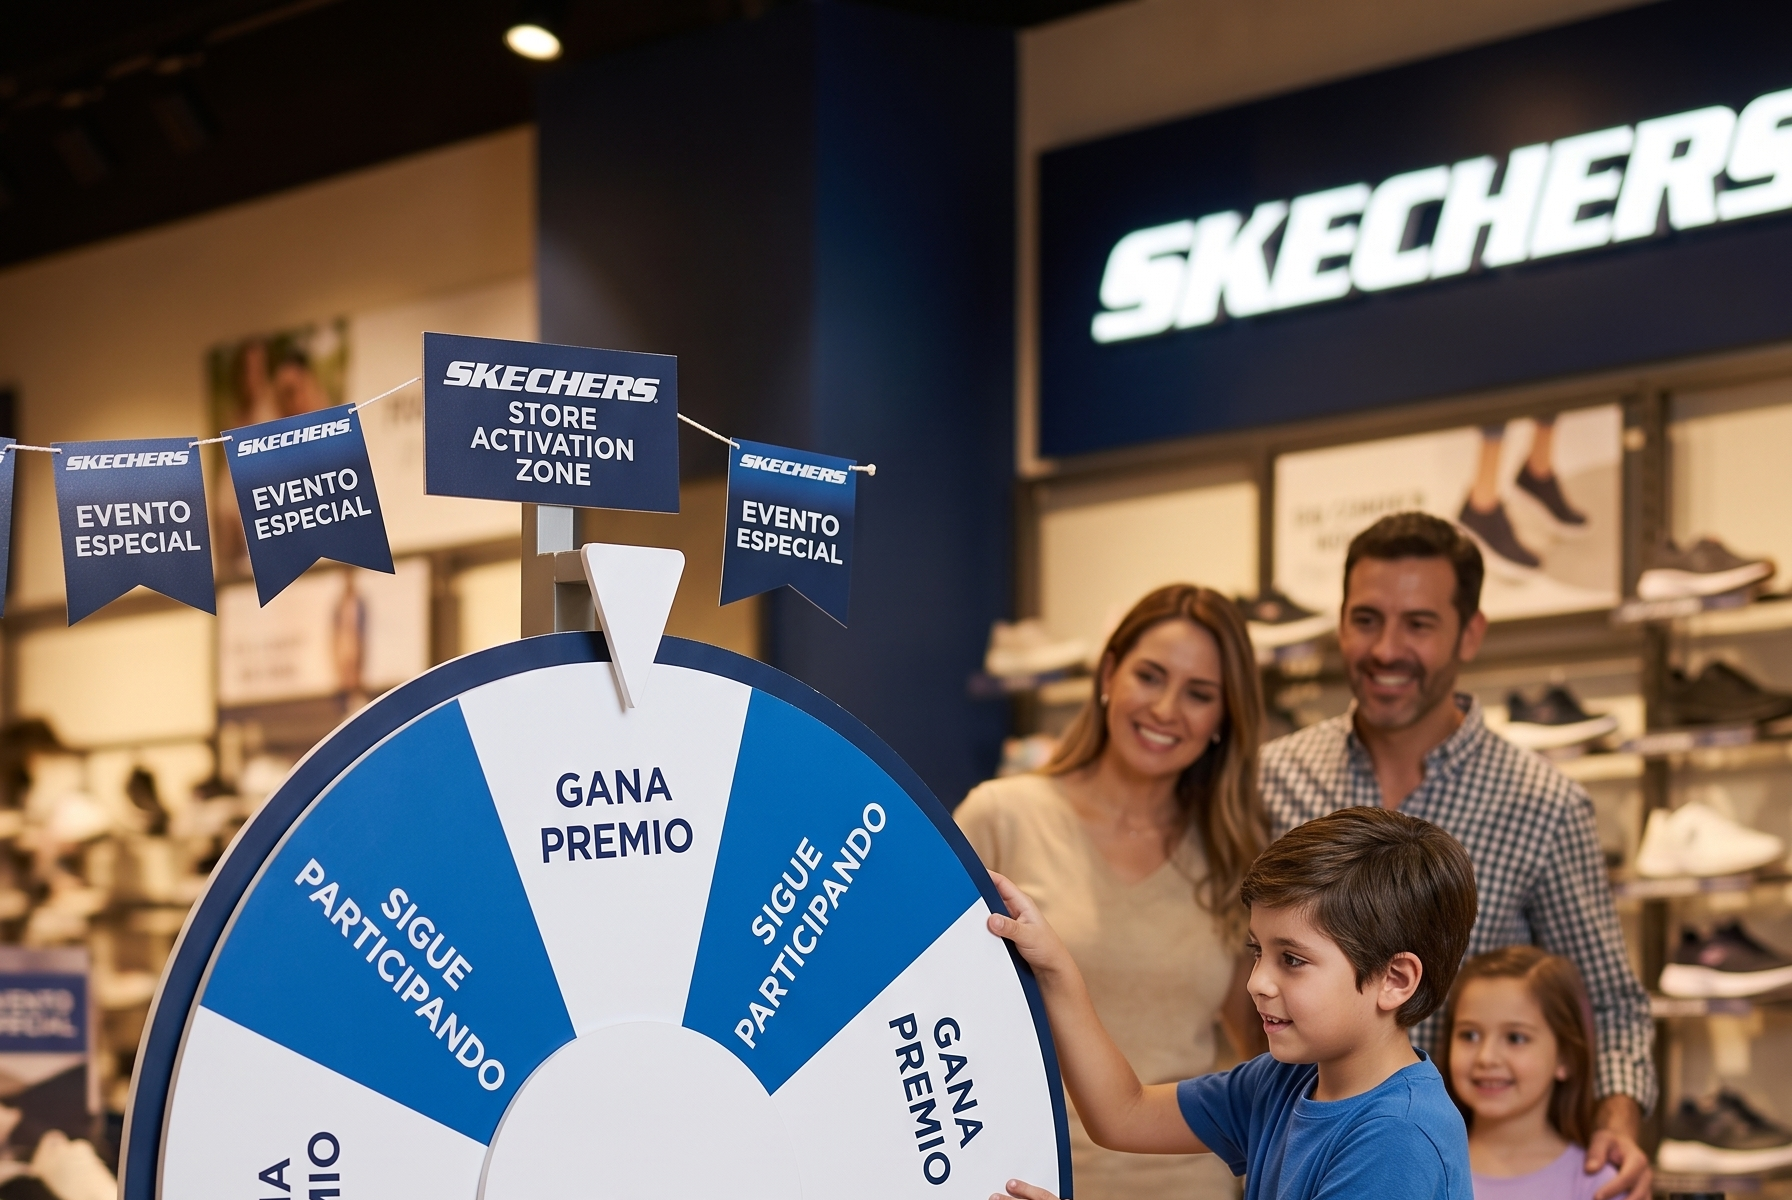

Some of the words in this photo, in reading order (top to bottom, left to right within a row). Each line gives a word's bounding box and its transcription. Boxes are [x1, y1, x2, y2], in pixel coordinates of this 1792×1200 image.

[1091, 86, 1792, 343] SKECHERS
[443, 360, 661, 404] SKECHERS
[508, 400, 597, 431] STORE
[237, 417, 353, 458] SKECHERS
[470, 426, 634, 462] ACTIVATION
[65, 450, 190, 471] SKECHERS
[516, 458, 591, 486] ZONE
[739, 453, 848, 485] SKECHERS
[251, 468, 358, 511] EVENTO
[76, 500, 191, 528] EVENTO
[254, 495, 372, 540] ESPECIAL
[742, 499, 840, 537] EVENTO
[75, 530, 202, 558] ESPECIAL
[736, 527, 843, 565] ESPECIAL
[555, 766, 673, 809] GANA
[540, 817, 694, 864] PREMIO
[751, 836, 823, 946] SIGUE
[380, 887, 473, 992] SIGUE
[734, 802, 887, 1050] PARTICIPANDO
[294, 857, 505, 1091] PARTICIPANDO
[888, 1012, 951, 1186] PREMIO
[933, 1016, 984, 1150] GANA
